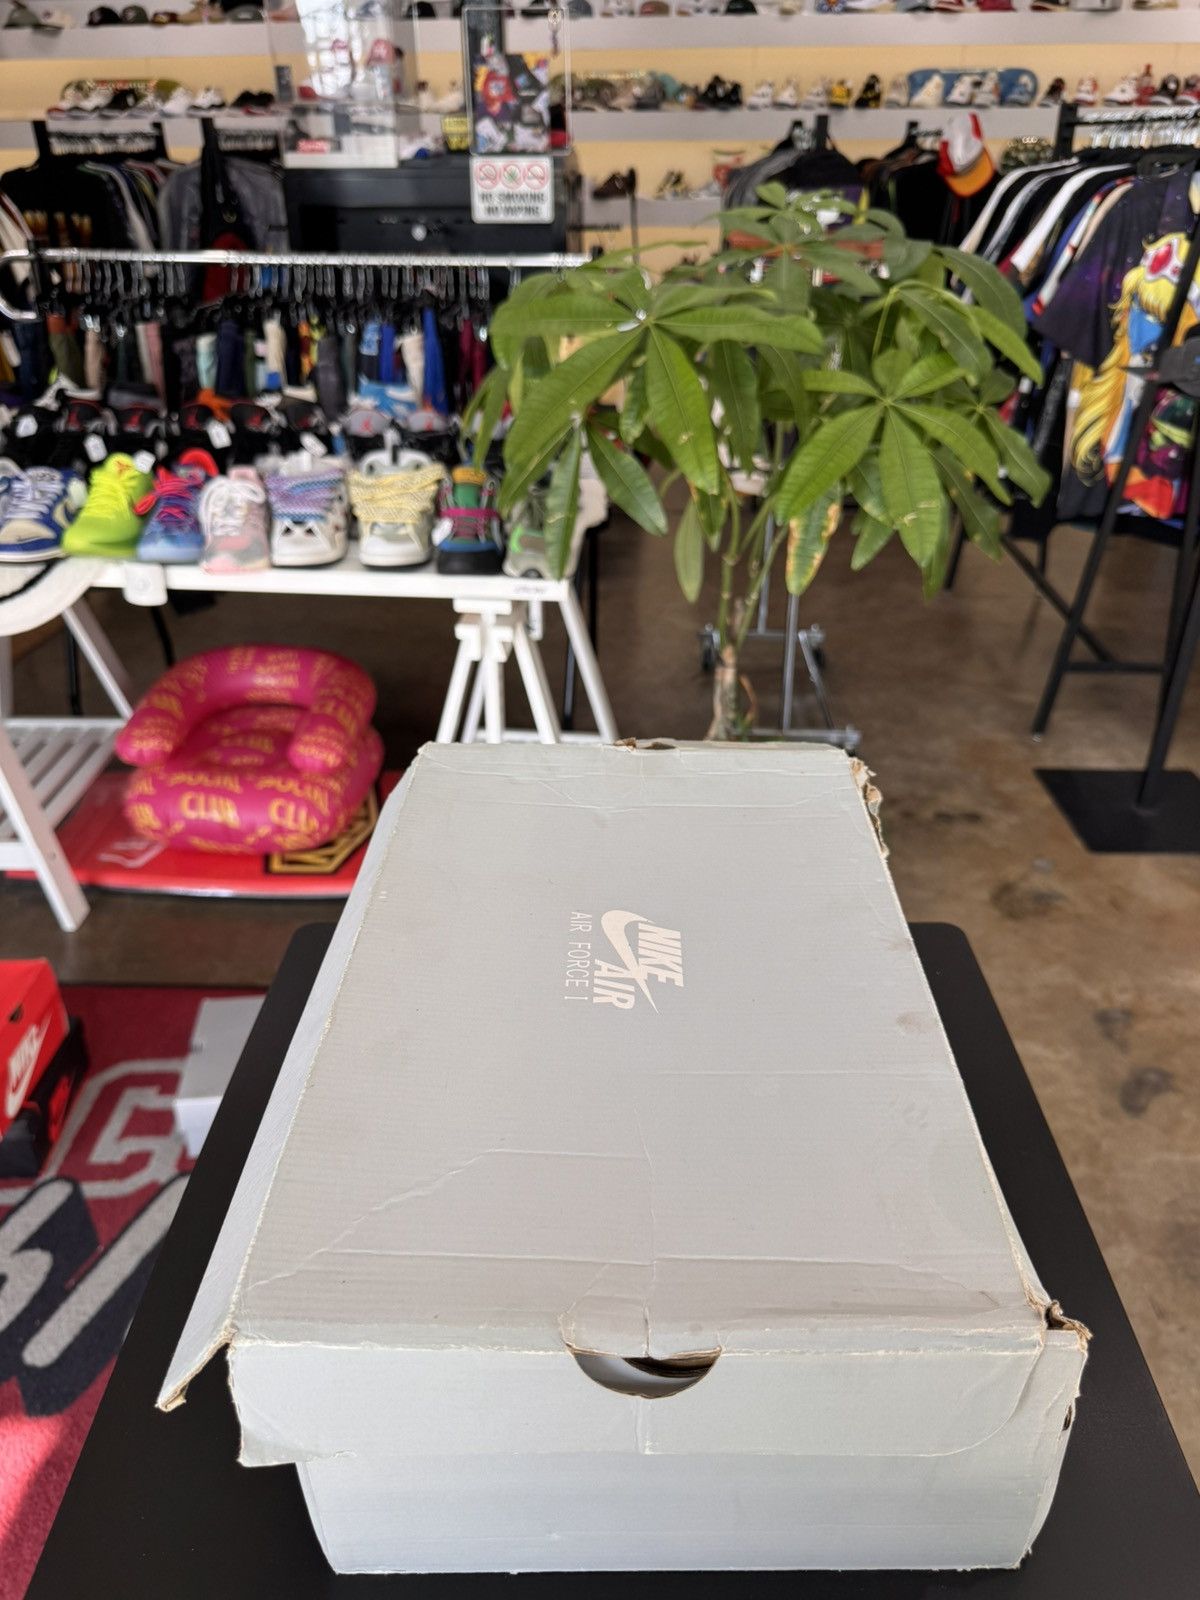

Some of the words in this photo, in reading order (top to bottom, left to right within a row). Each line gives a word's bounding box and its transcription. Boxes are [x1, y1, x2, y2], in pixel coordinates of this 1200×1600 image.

[570, 911, 592, 932] AIR
[565, 942, 591, 987] FORCE
[638, 922, 684, 987] NIKE
[592, 958, 636, 1010] AIR
